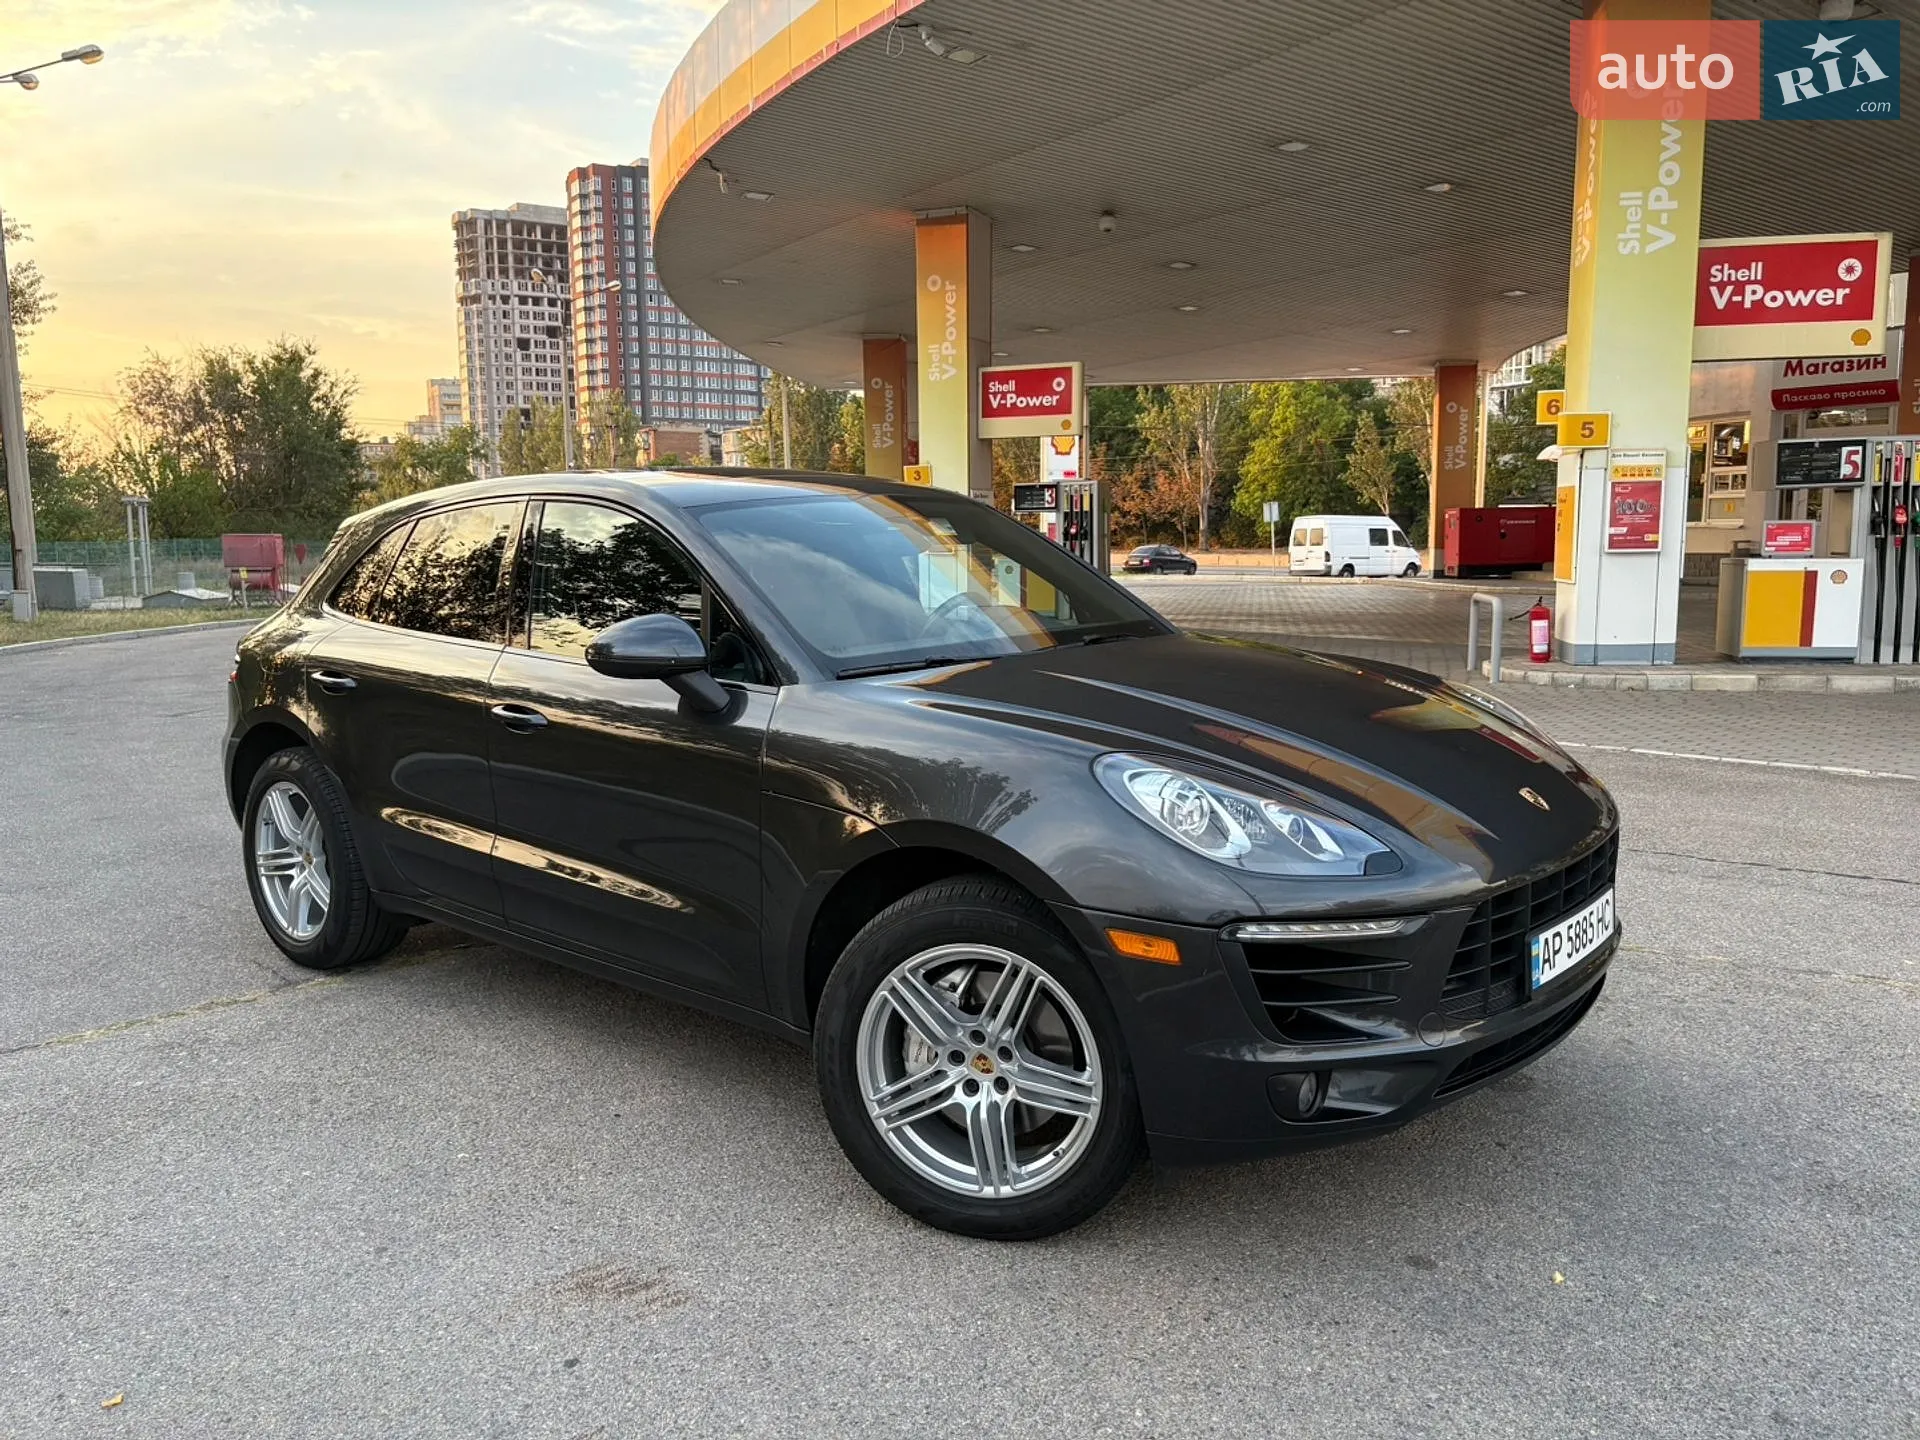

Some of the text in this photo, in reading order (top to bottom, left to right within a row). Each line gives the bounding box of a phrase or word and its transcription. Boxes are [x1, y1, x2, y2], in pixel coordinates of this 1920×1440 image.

[1617, 191, 1643, 256] Shell
[1709, 262, 1763, 283] Shell
[1709, 284, 1851, 310] V-Power
[941, 280, 957, 381] V-Power
[928, 343, 940, 382] Shell
[1783, 356, 1887, 378] Магазин
[988, 380, 1016, 393] Shell
[1783, 388, 1886, 403] Ласкаво просимо
[988, 393, 1060, 409] V-Power
[1546, 398, 1561, 416] 6
[882, 381, 895, 449] V-Power
[1455, 406, 1469, 470] V-Power
[1580, 421, 1595, 439] 5
[913, 470, 922, 481] 3
[1842, 449, 1860, 480] 5
[1046, 487, 1055, 505] 3
[1541, 898, 1610, 976] AP 5885 HC
